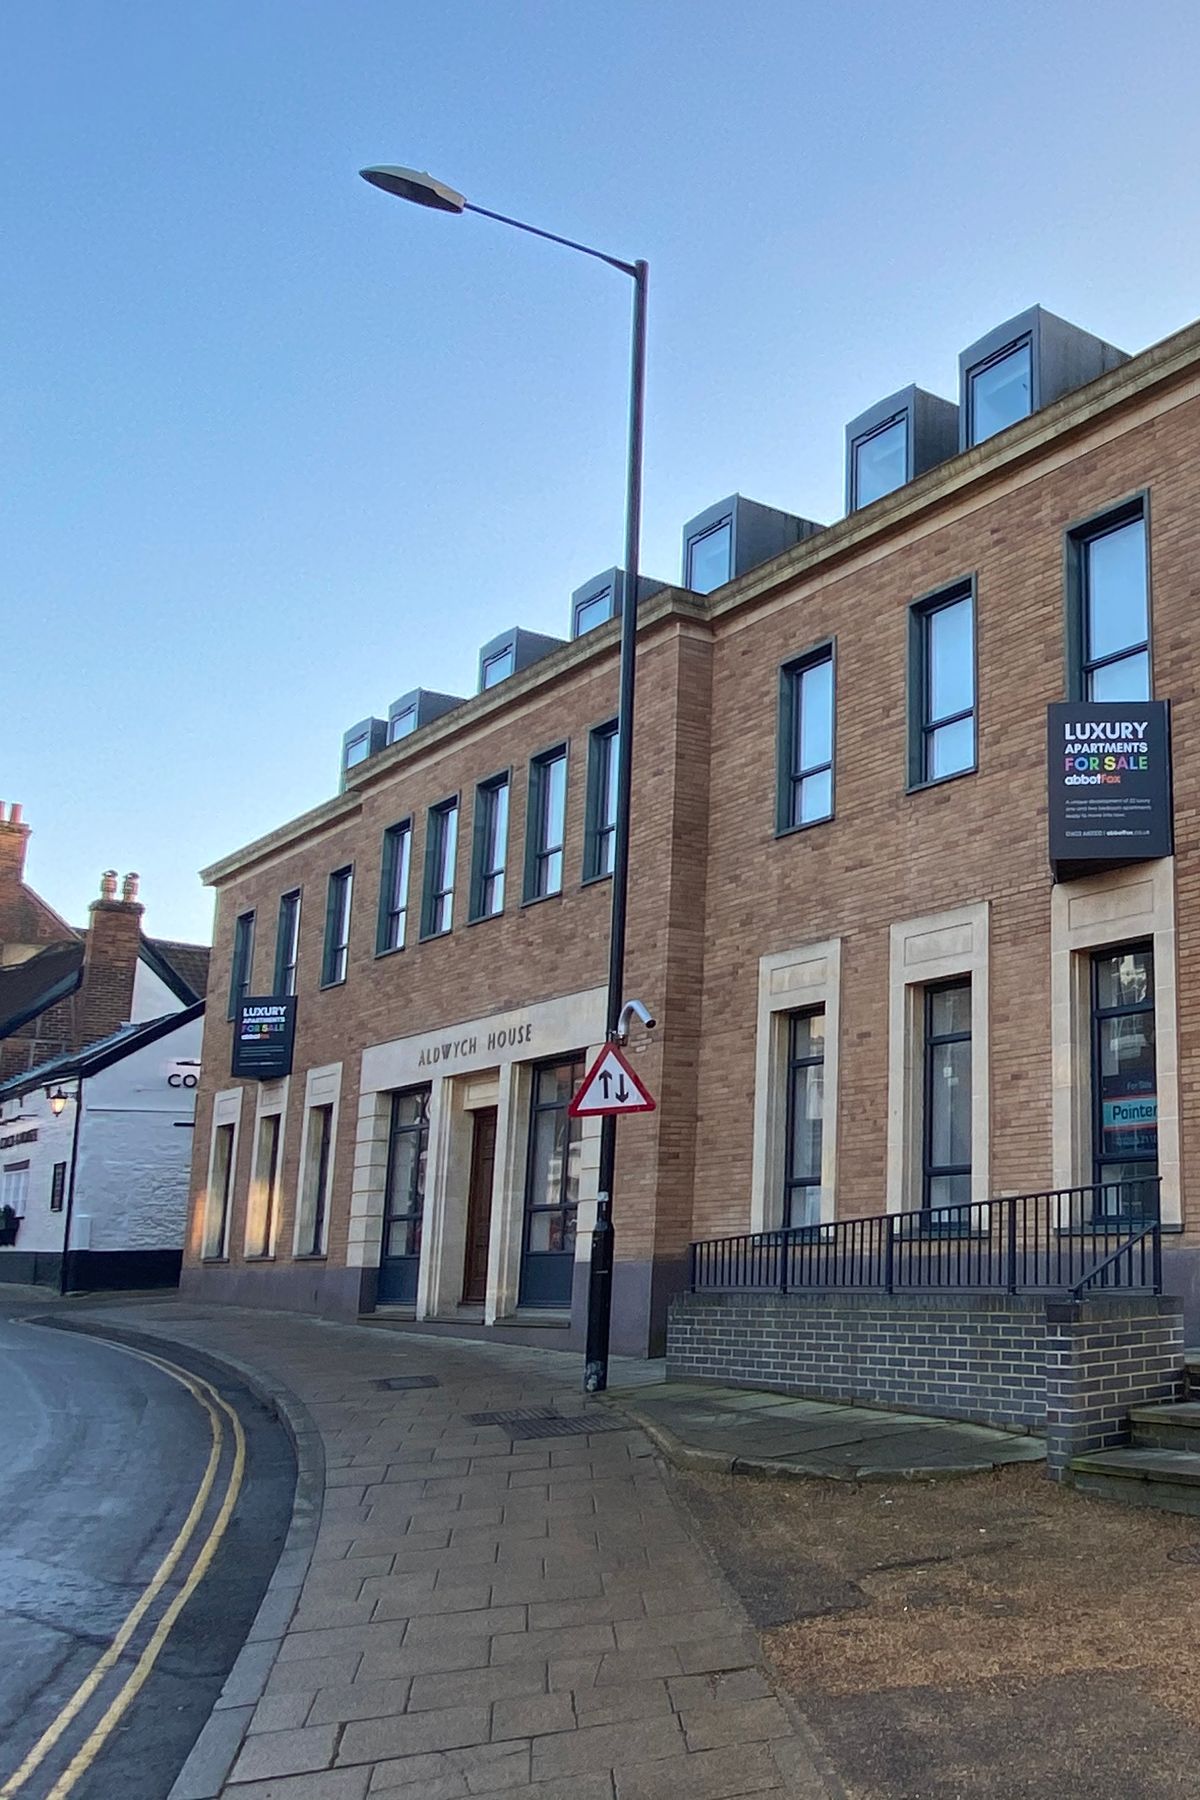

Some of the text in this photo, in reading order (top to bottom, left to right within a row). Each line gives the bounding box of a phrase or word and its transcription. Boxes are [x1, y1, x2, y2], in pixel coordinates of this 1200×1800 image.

[1064, 721, 1148, 740] LUXURY
[1064, 742, 1148, 755] APARTMENTS
[1065, 756, 1148, 772] FOR SALE
[243, 1006, 287, 1017] LUXURY
[418, 1023, 532, 1067] ALDWYCH HOUSE
